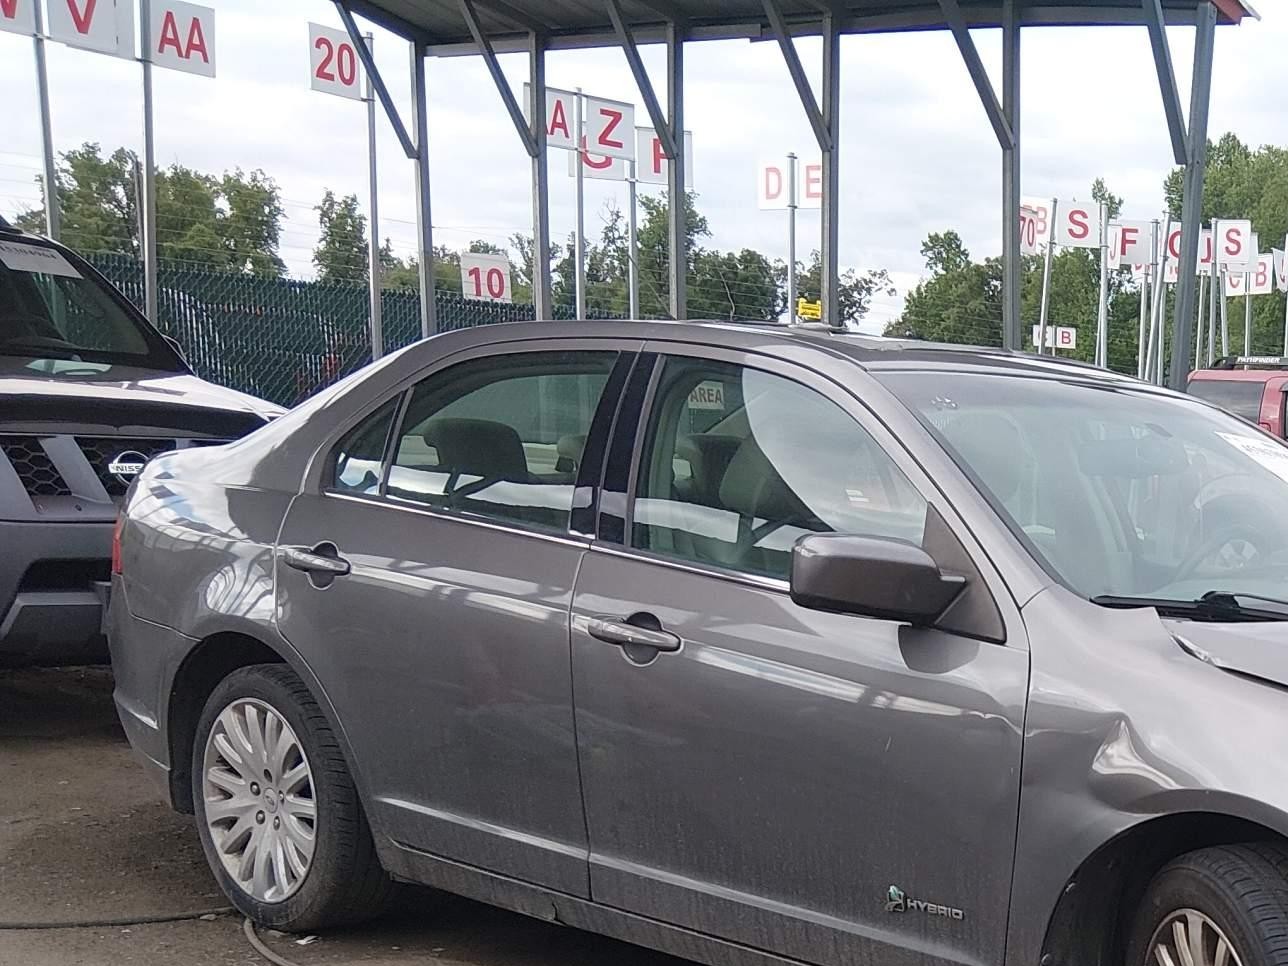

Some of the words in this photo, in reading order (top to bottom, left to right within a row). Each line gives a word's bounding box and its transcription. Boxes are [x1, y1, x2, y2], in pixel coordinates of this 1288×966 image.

[158, 11, 209, 63] AA
[315, 37, 355, 86] 20
[598, 108, 624, 148] Z
[765, 167, 782, 200] D
[806, 165, 823, 198] E
[1068, 209, 1089, 239] S
[1120, 228, 1138, 256] F
[1225, 228, 1241, 256] S
[468, 267, 504, 298] 10
[1062, 330, 1072, 344] B
[690, 387, 722, 404] AREA
[907, 898, 964, 920] HYBRID
